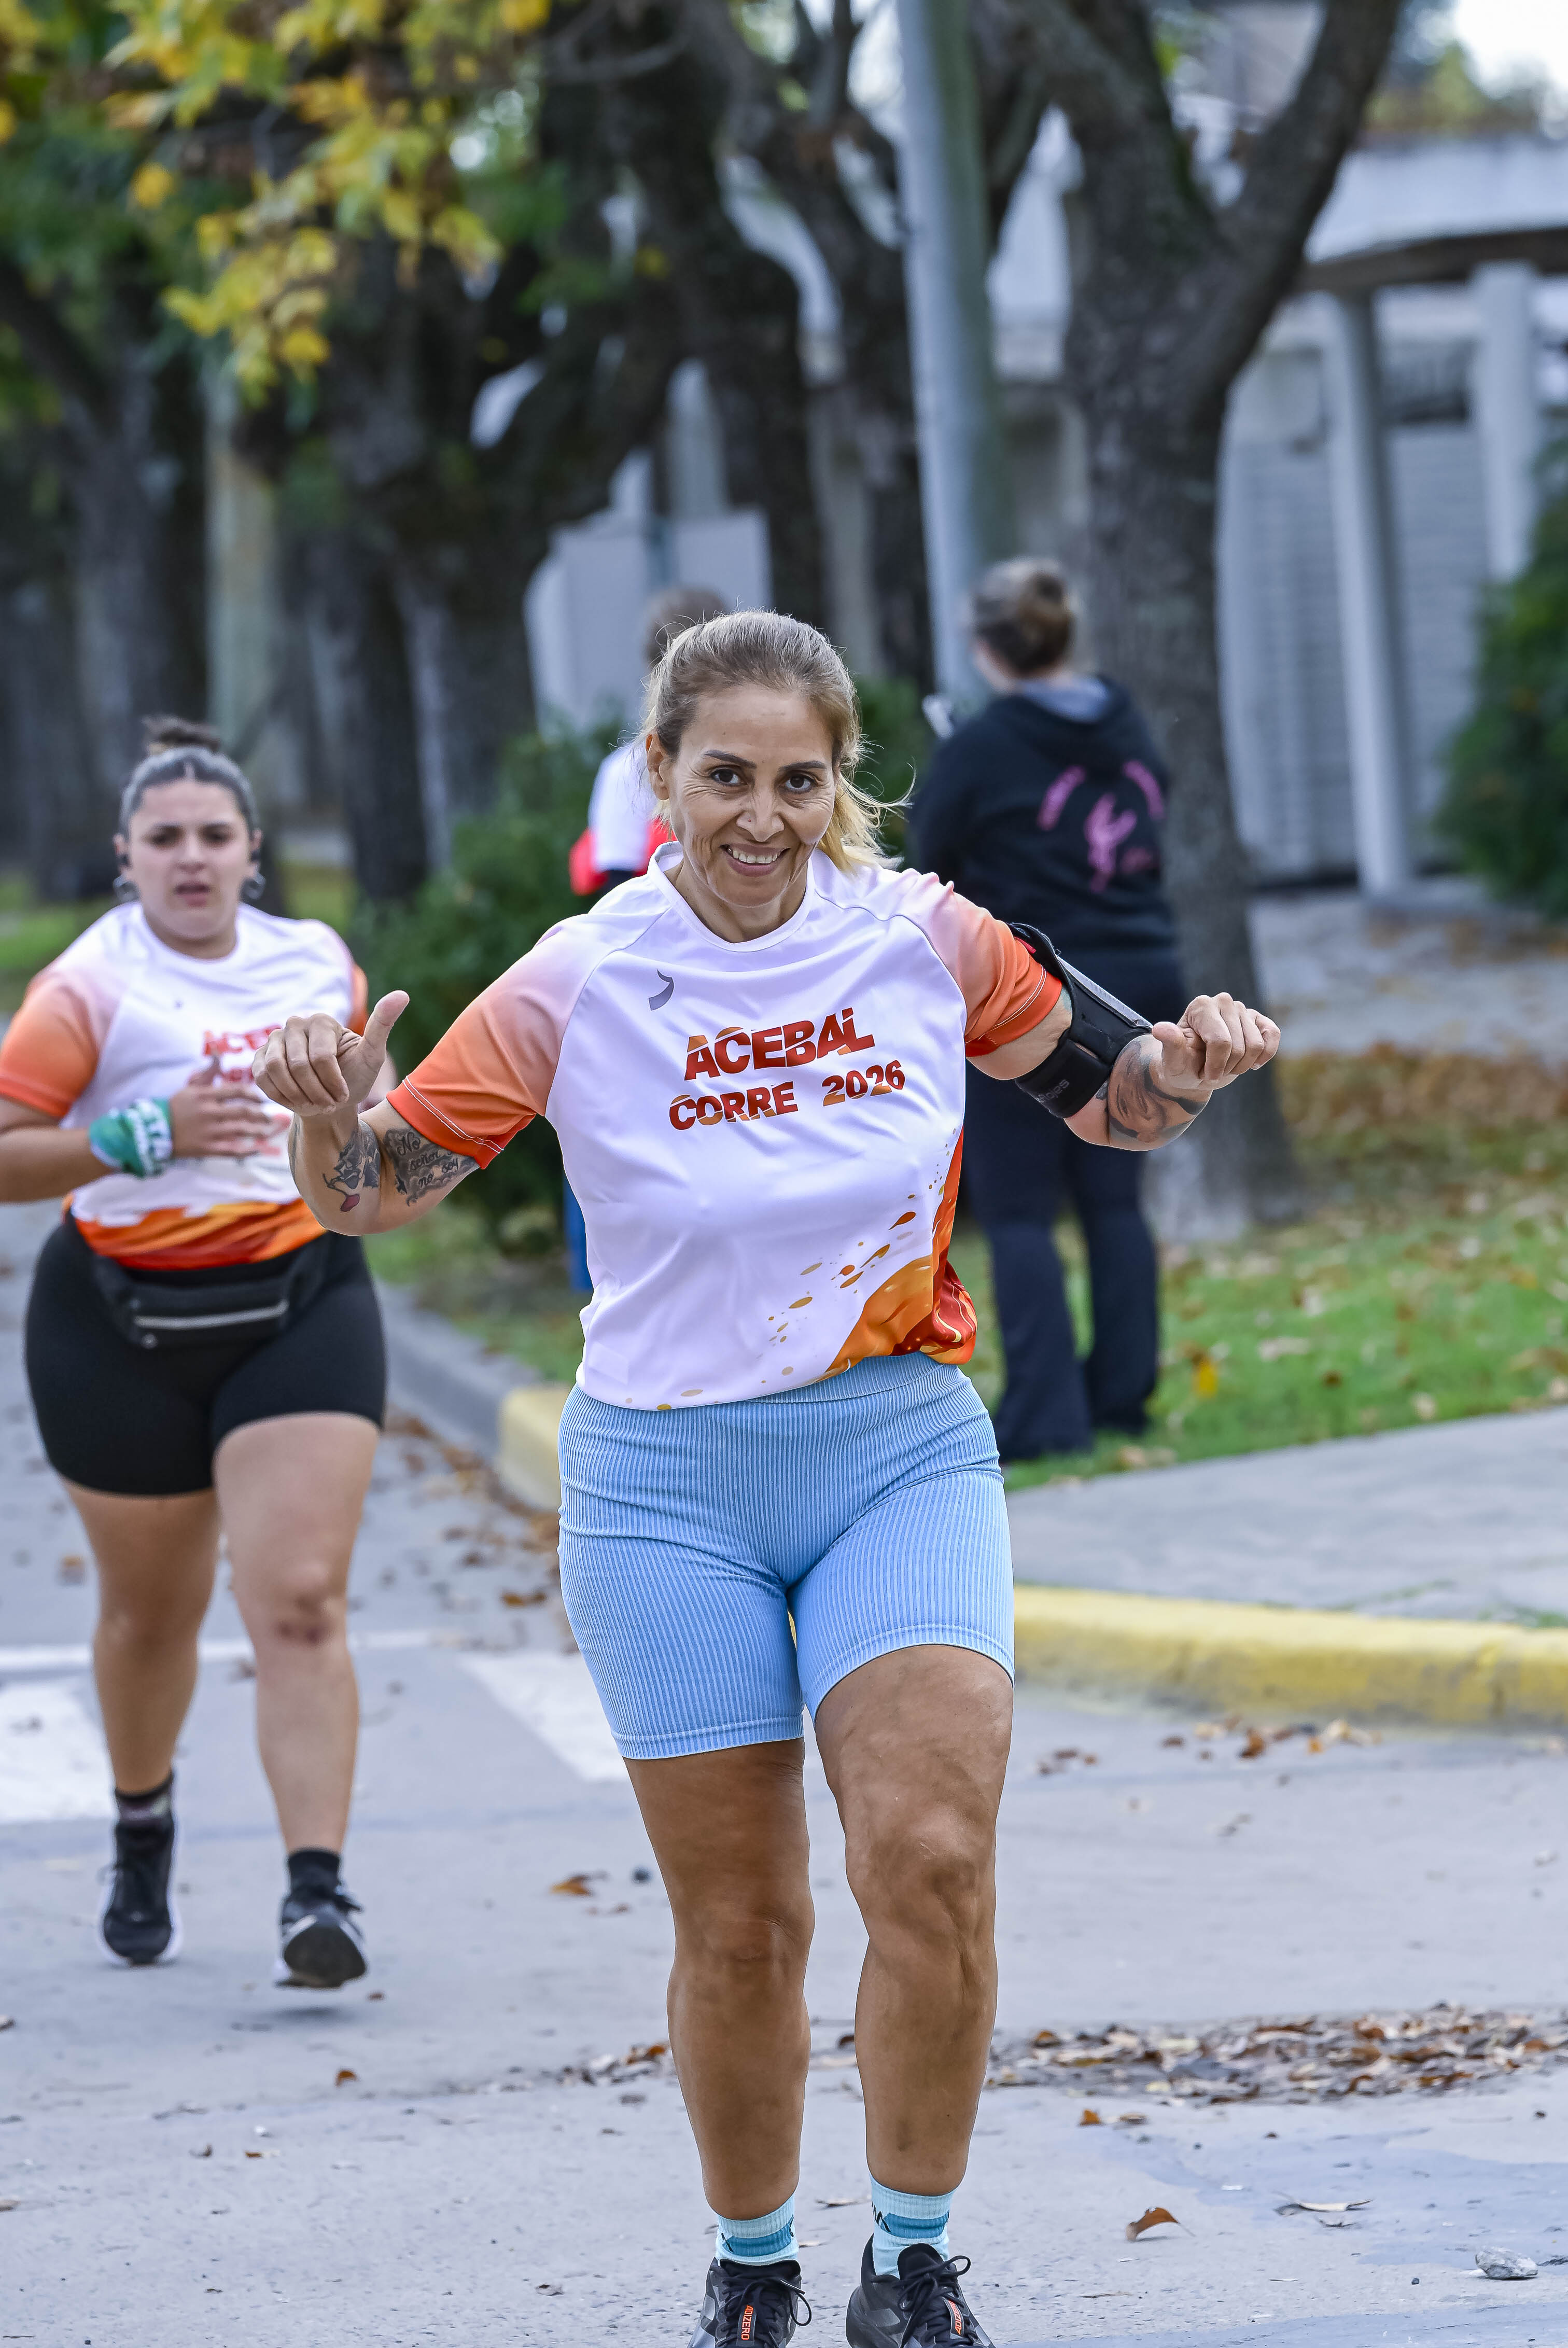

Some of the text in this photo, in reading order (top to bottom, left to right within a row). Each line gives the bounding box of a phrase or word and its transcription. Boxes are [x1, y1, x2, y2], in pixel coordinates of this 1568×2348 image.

[684, 1007, 875, 1081] ACEBAL
[669, 1059, 905, 1130] CORRE 2026
[1036, 1079, 1069, 1103] salo
[418, 1173, 433, 1188] no
[741, 2305, 754, 2340] ADIZERO
